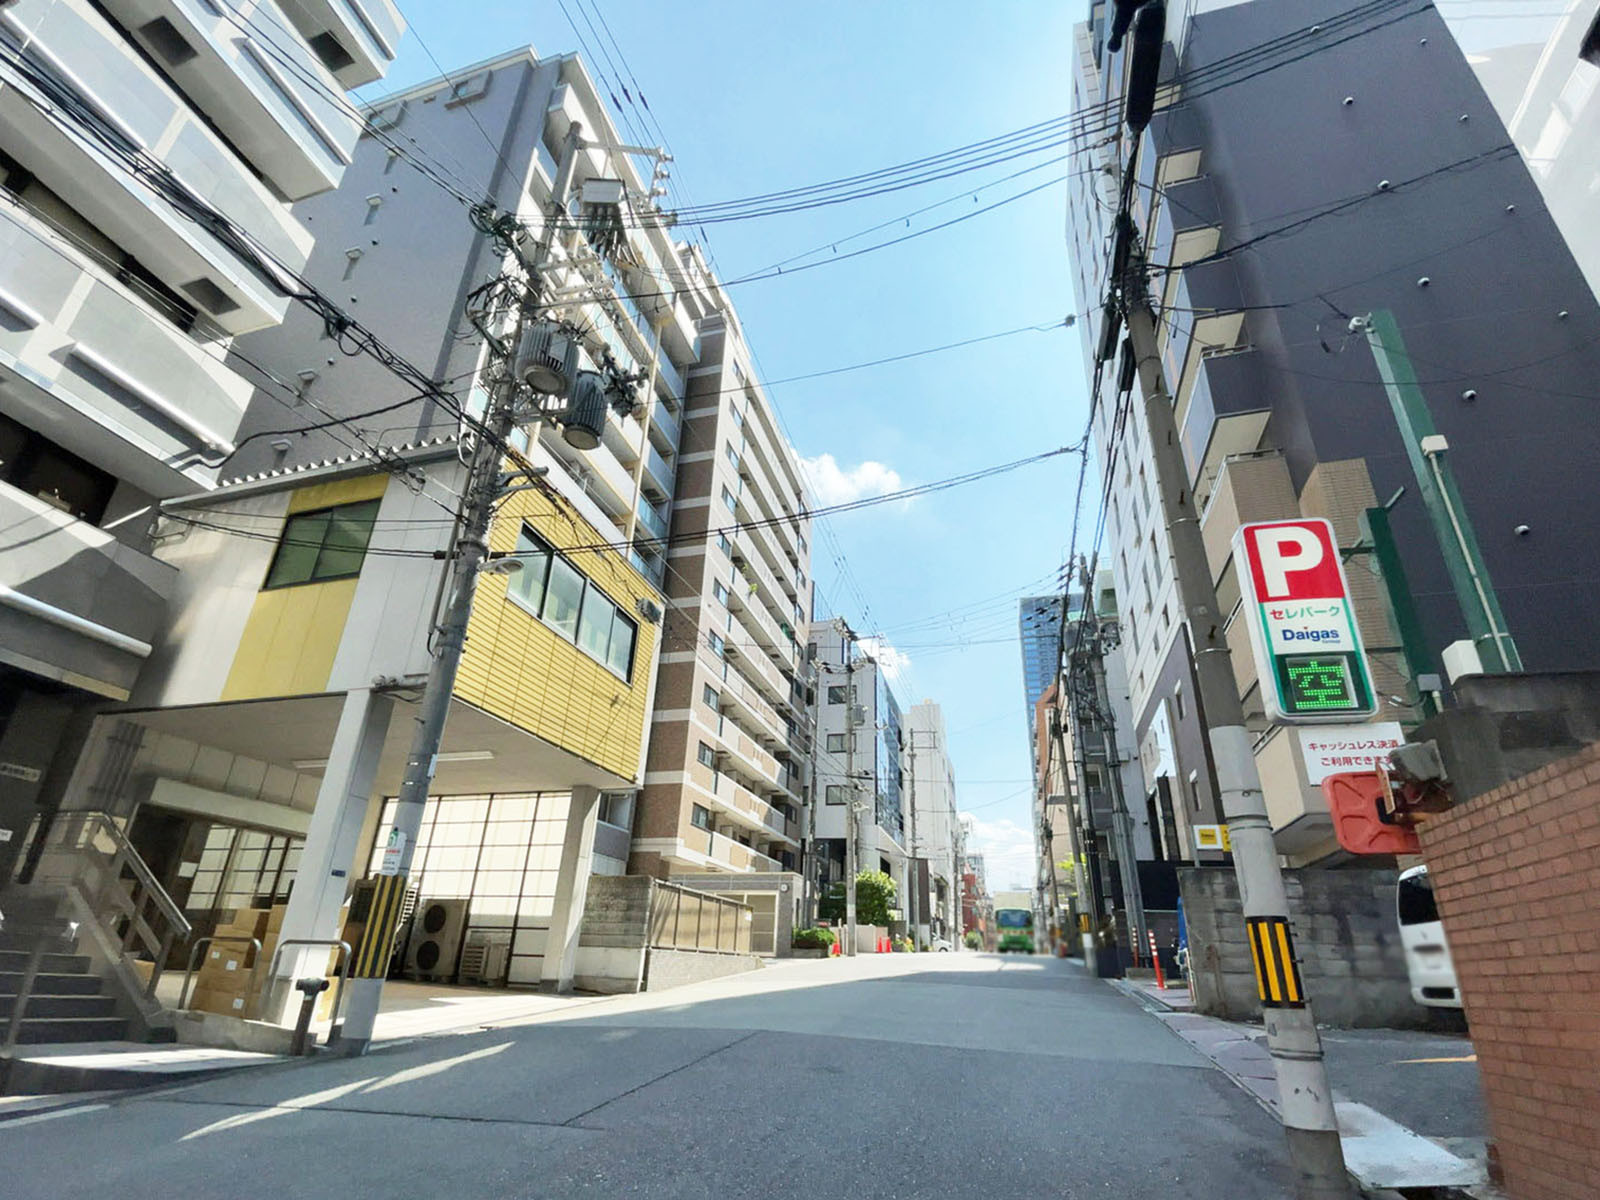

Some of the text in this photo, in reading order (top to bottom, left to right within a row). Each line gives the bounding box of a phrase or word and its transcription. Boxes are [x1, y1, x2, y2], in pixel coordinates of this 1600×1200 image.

[1254, 526, 1324, 598] P
[1282, 626, 1340, 642] Daigas
[1287, 660, 1353, 709] 空
